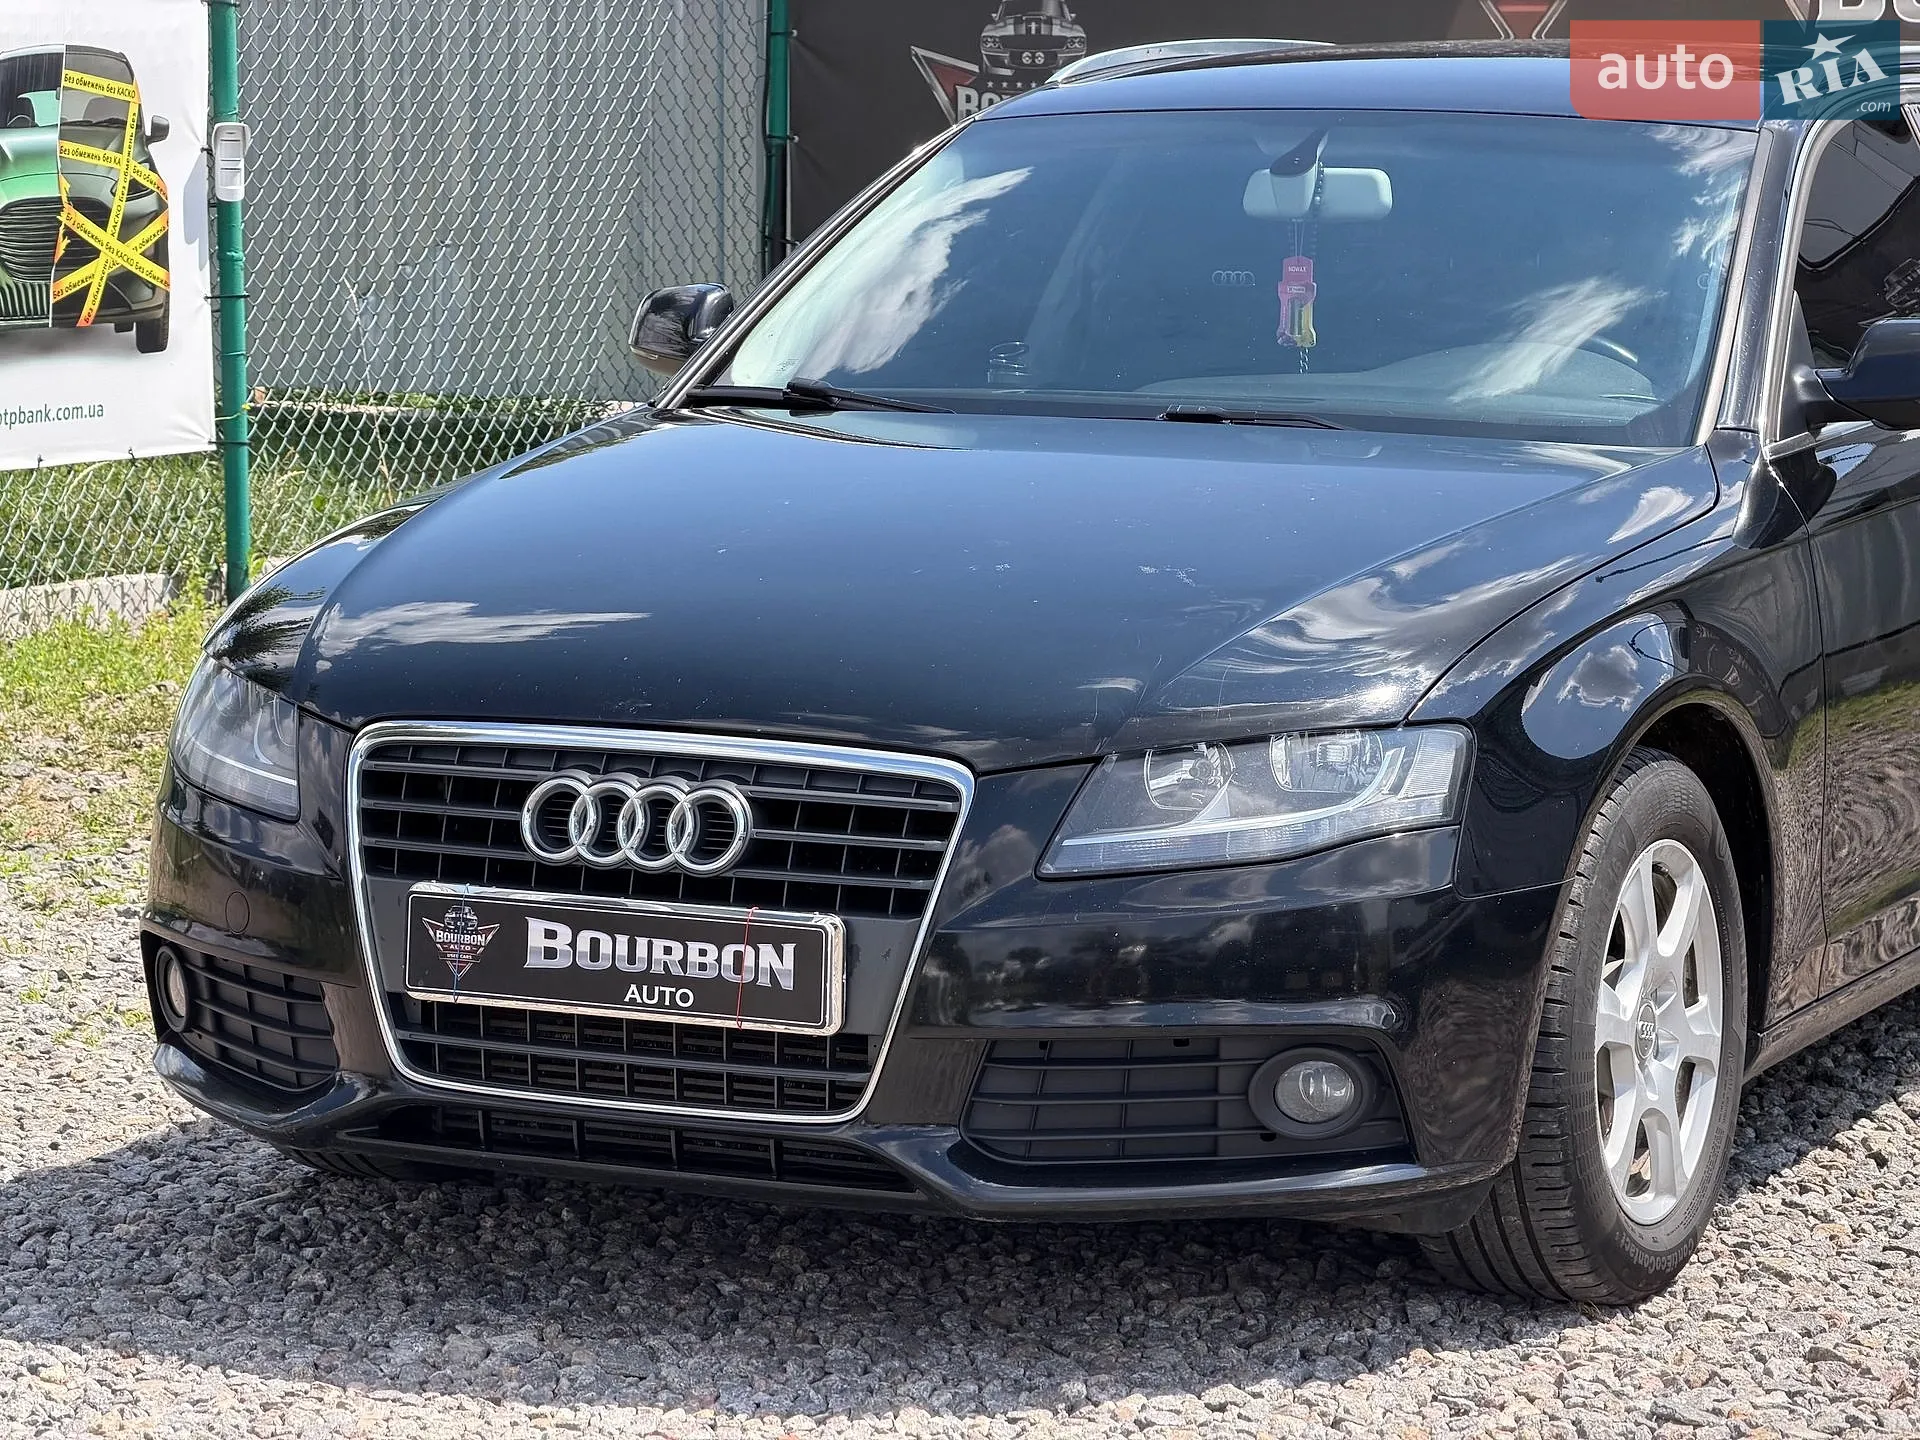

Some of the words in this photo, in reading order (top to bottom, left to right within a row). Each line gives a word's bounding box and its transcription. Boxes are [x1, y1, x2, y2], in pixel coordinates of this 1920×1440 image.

[75, 77, 105, 92] обмежень
[116, 86, 136, 99] КАСКО
[110, 204, 122, 238] КАСКО
[115, 249, 136, 267] КАСКО
[435, 930, 486, 947] BOURBON
[523, 917, 797, 991] BOURBON
[624, 984, 695, 1008] AUTO
